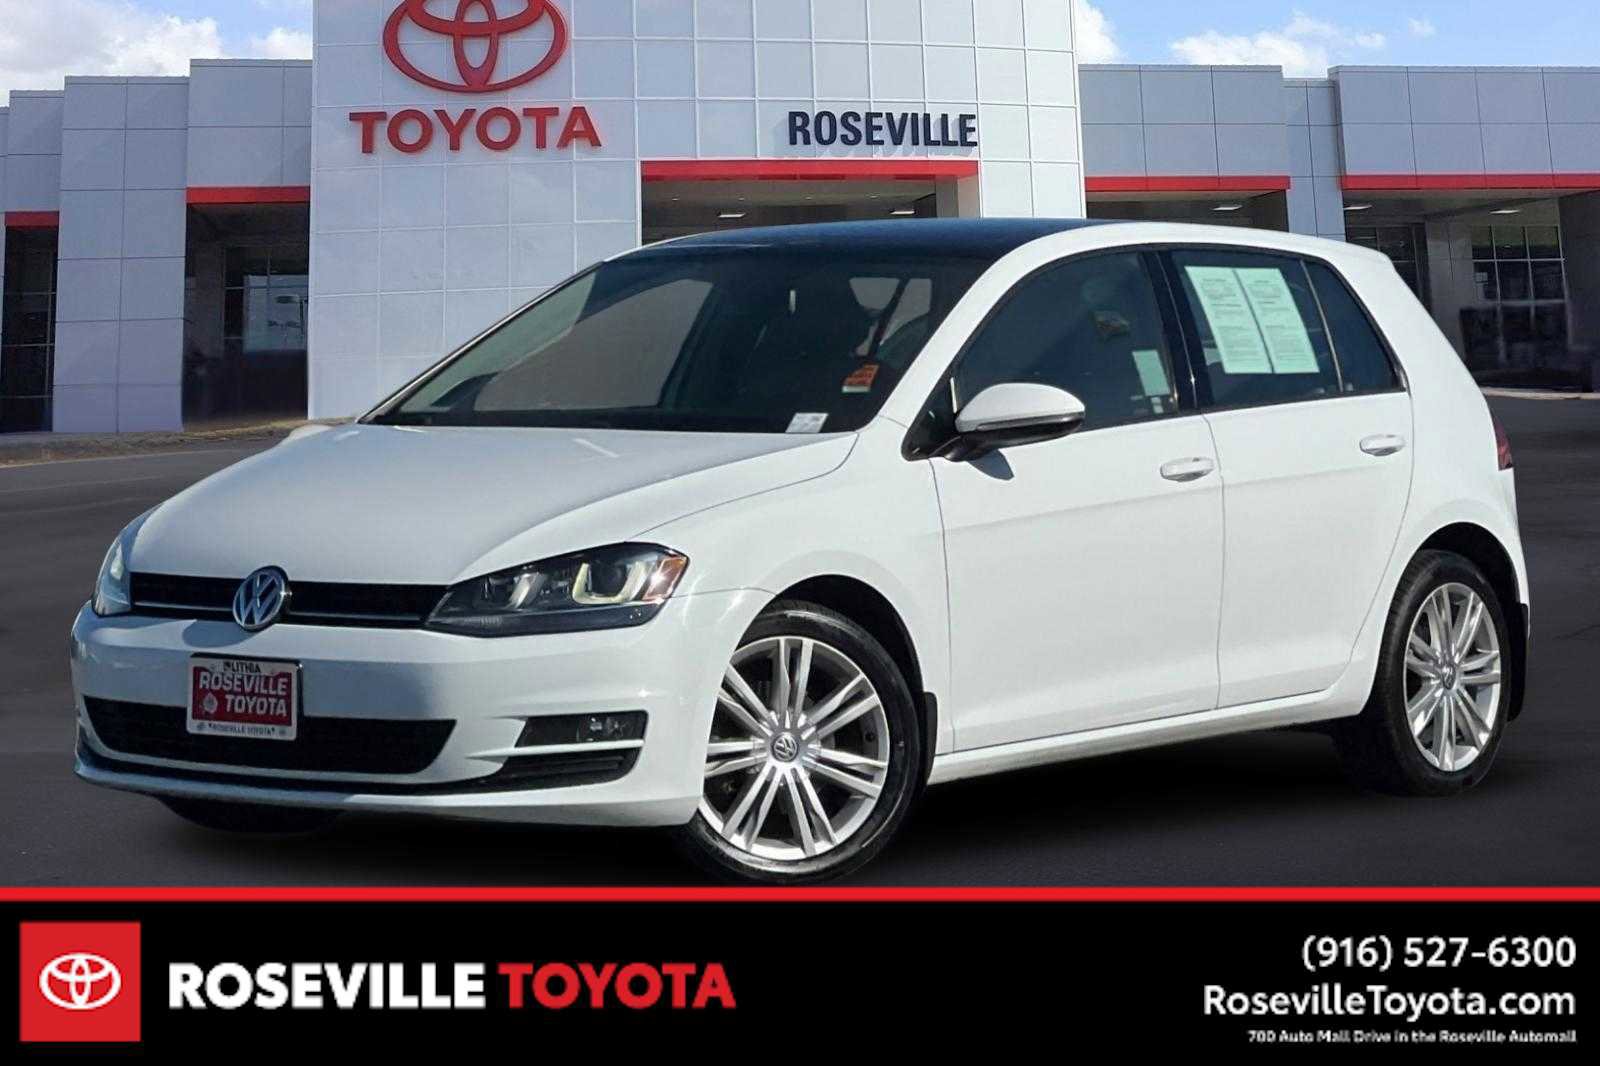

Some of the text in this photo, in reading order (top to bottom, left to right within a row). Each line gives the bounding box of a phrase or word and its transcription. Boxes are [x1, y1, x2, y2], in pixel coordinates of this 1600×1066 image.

[349, 105, 603, 154] TOYOTA
[788, 110, 978, 147] ROSEVILLE
[231, 661, 261, 673] LITHIA
[199, 671, 288, 695] ROSEVILLE
[224, 694, 287, 717] TOYOTA
